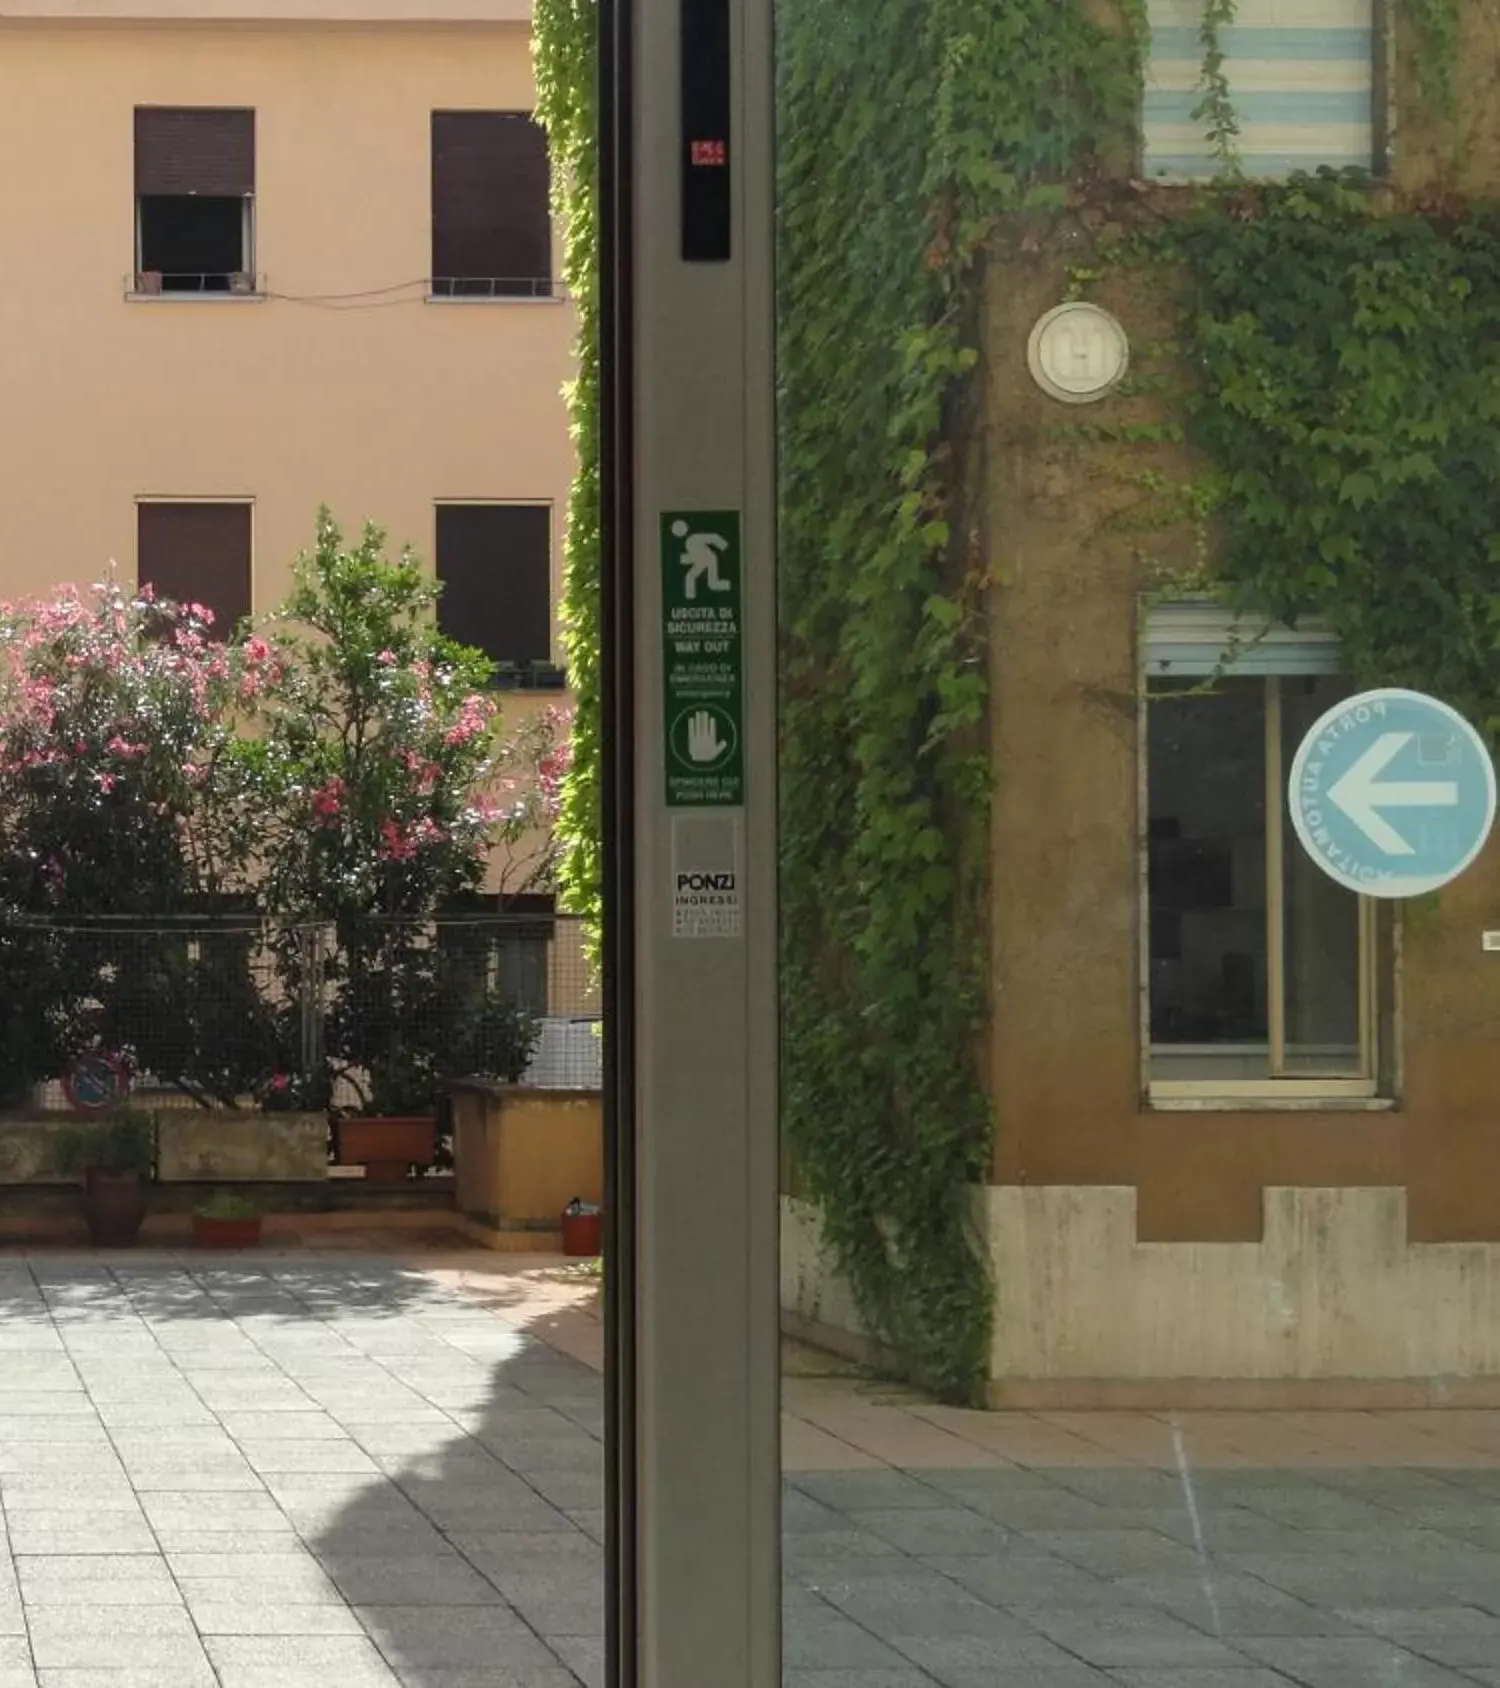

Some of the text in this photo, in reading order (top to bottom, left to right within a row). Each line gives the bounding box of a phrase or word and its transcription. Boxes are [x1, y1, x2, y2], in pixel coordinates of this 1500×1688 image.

[671, 607, 733, 619] USCITA DI
[667, 621, 737, 633] SICUREZZA
[674, 641, 729, 652] WAY OUT
[677, 873, 735, 891] PONZI
[675, 895, 737, 905] INGRESSI
